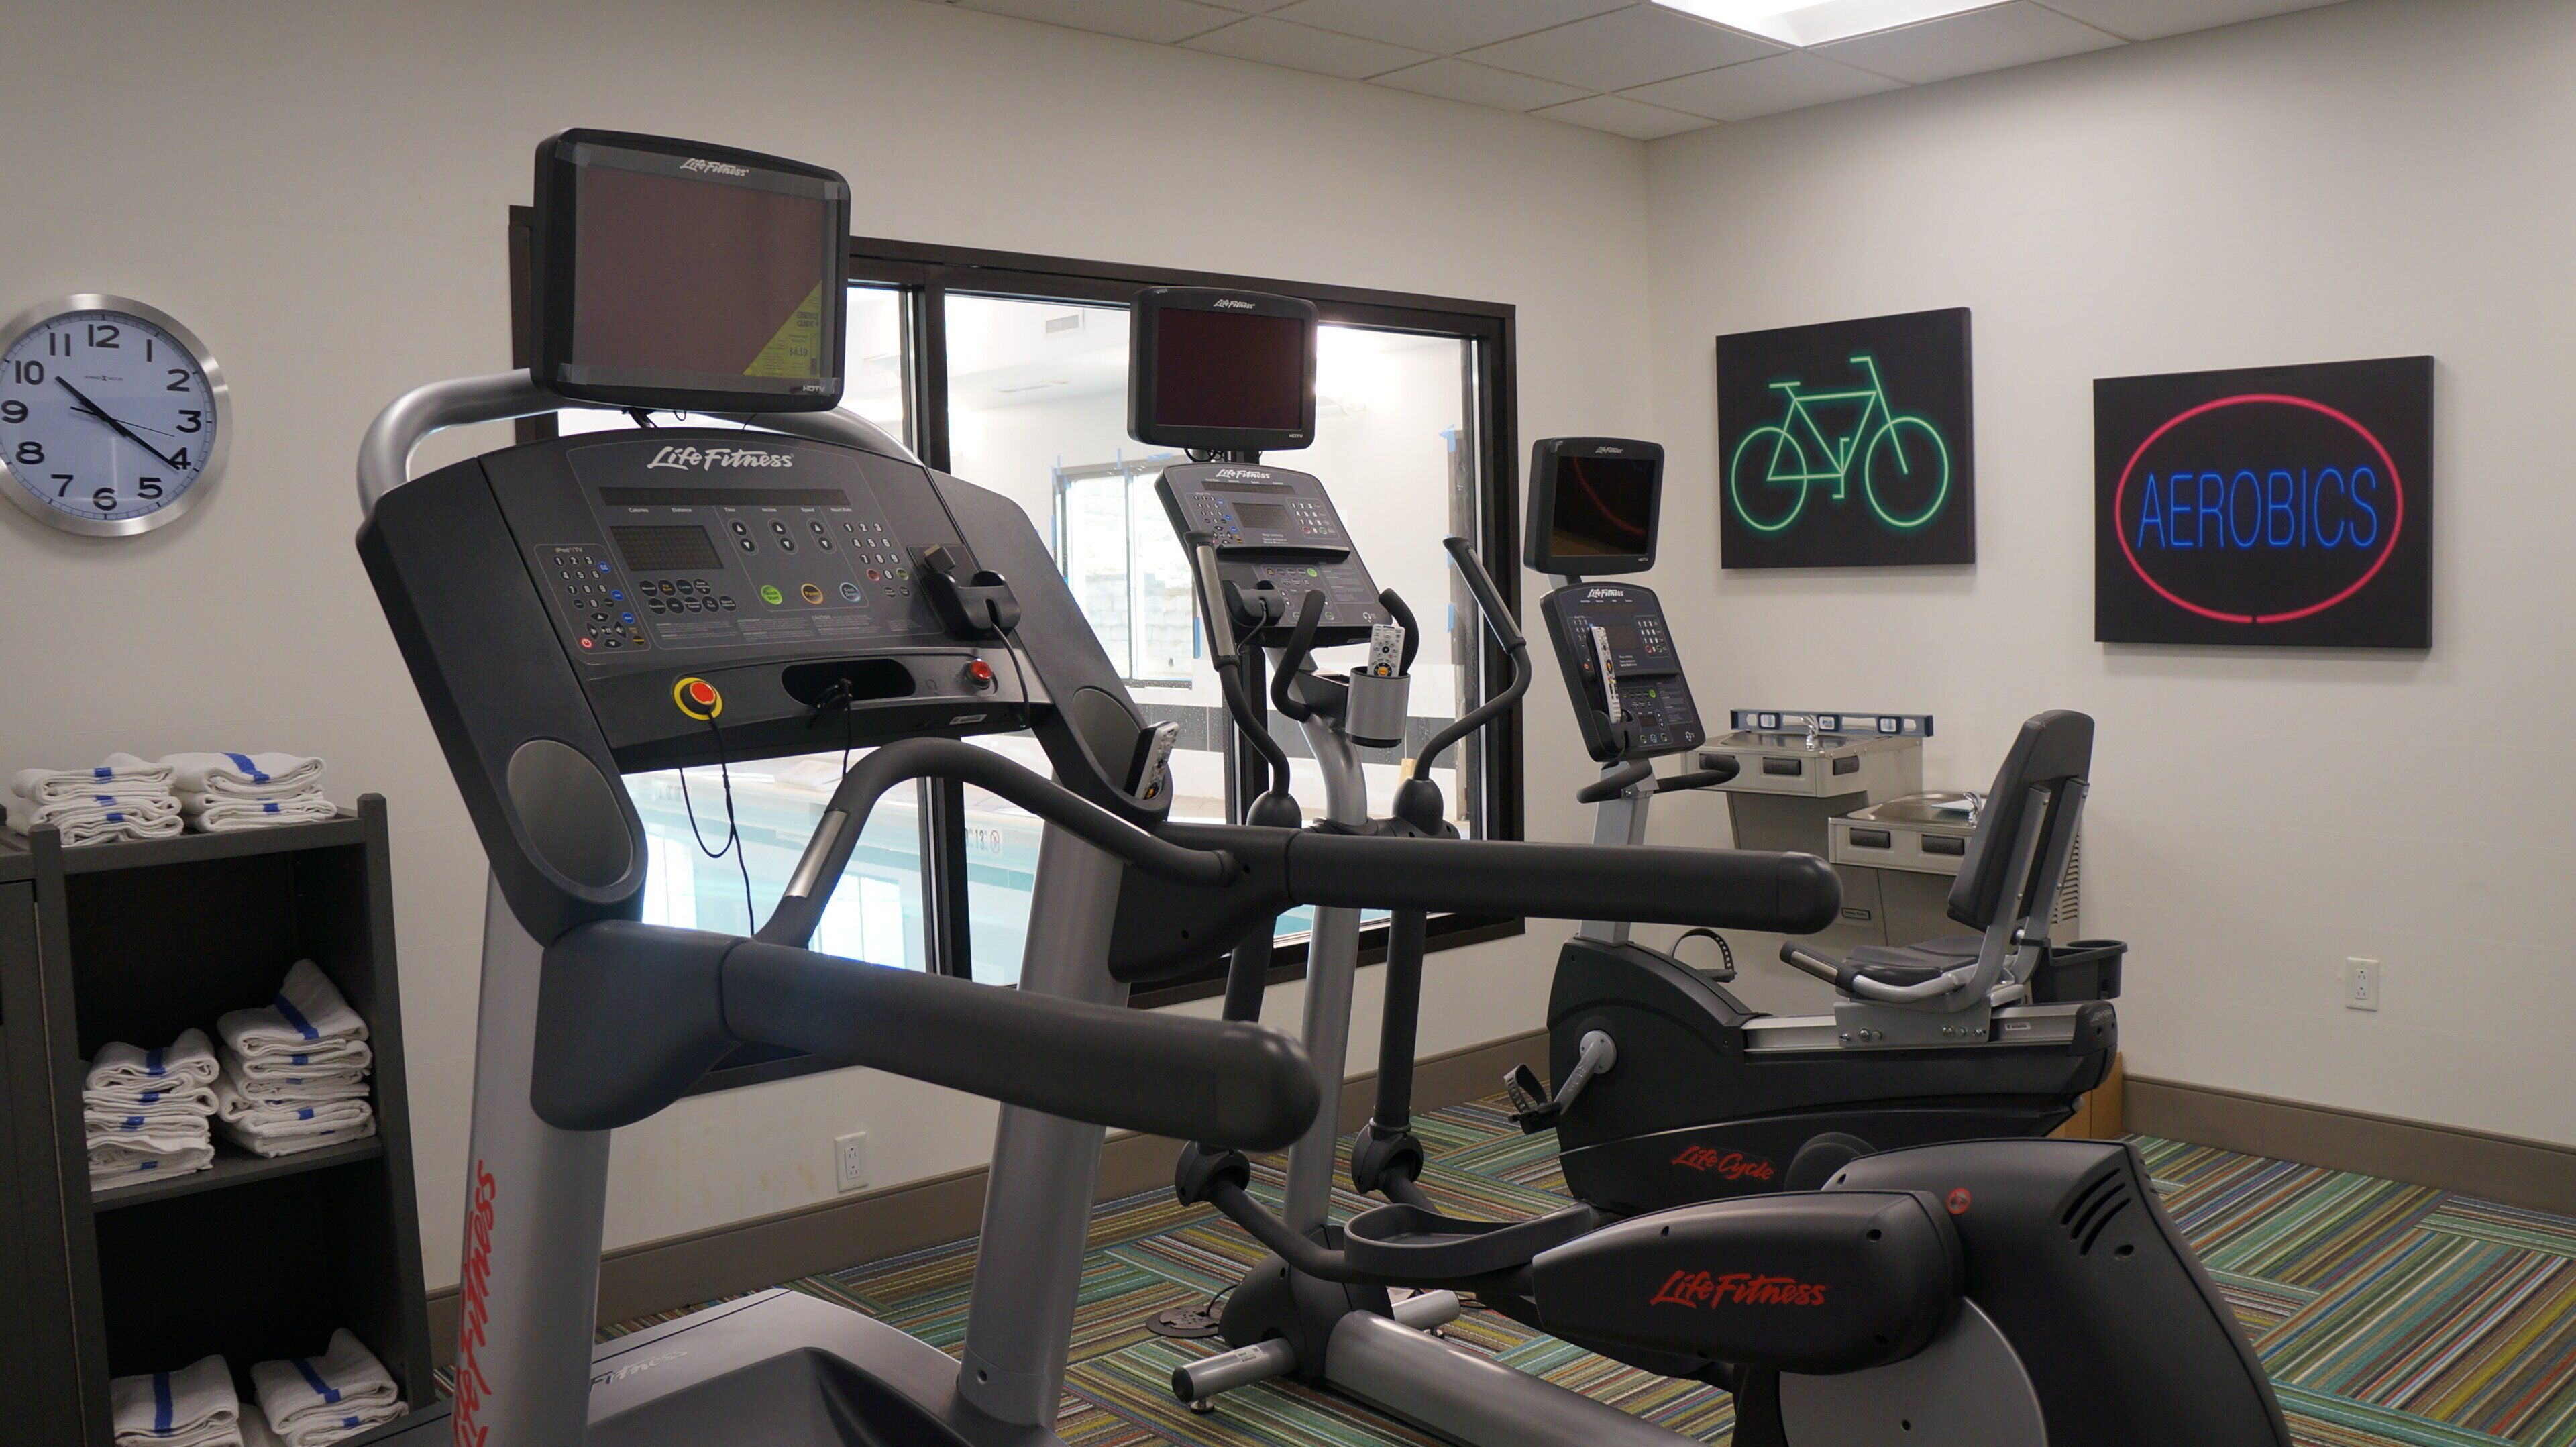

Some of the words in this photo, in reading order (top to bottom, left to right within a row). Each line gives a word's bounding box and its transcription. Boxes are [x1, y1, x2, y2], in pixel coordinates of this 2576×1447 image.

[50, 332, 70, 356] 11
[88, 324, 119, 348] 12
[147, 339, 152, 362] 1
[15, 360, 44, 385] 10
[166, 369, 190, 392] 2
[1, 400, 28, 423] 9
[176, 410, 201, 433] 3
[16, 441, 45, 464] 8
[168, 447, 191, 470] 4
[647, 446, 702, 470] Life
[704, 449, 794, 471] Fitness
[1216, 468, 1236, 478] Life
[51, 474, 74, 497] 7
[137, 477, 162, 500] 5
[93, 488, 117, 511] 6
[2137, 466, 2377, 549] AEROBICS
[845, 524, 851, 532] 1
[859, 523, 867, 532] 2
[874, 523, 881, 531] 3
[853, 539, 860, 547] 4
[867, 539, 875, 547] 5
[882, 539, 890, 547] 6
[570, 557, 578, 565] 2
[586, 557, 593, 565] 3
[862, 555, 868, 564] 7
[876, 554, 883, 564] 8
[890, 554, 898, 563] 9
[577, 571, 584, 579] 5
[592, 570, 600, 578] 6
[569, 586, 576, 594] 7
[584, 585, 591, 593] 8
[599, 584, 606, 592] 9
[1671, 1146, 1719, 1171] Life
[1718, 1153, 1774, 1180] Cycle
[1649, 1270, 1715, 1309] Life
[1711, 1273, 1826, 1309] Fitness
